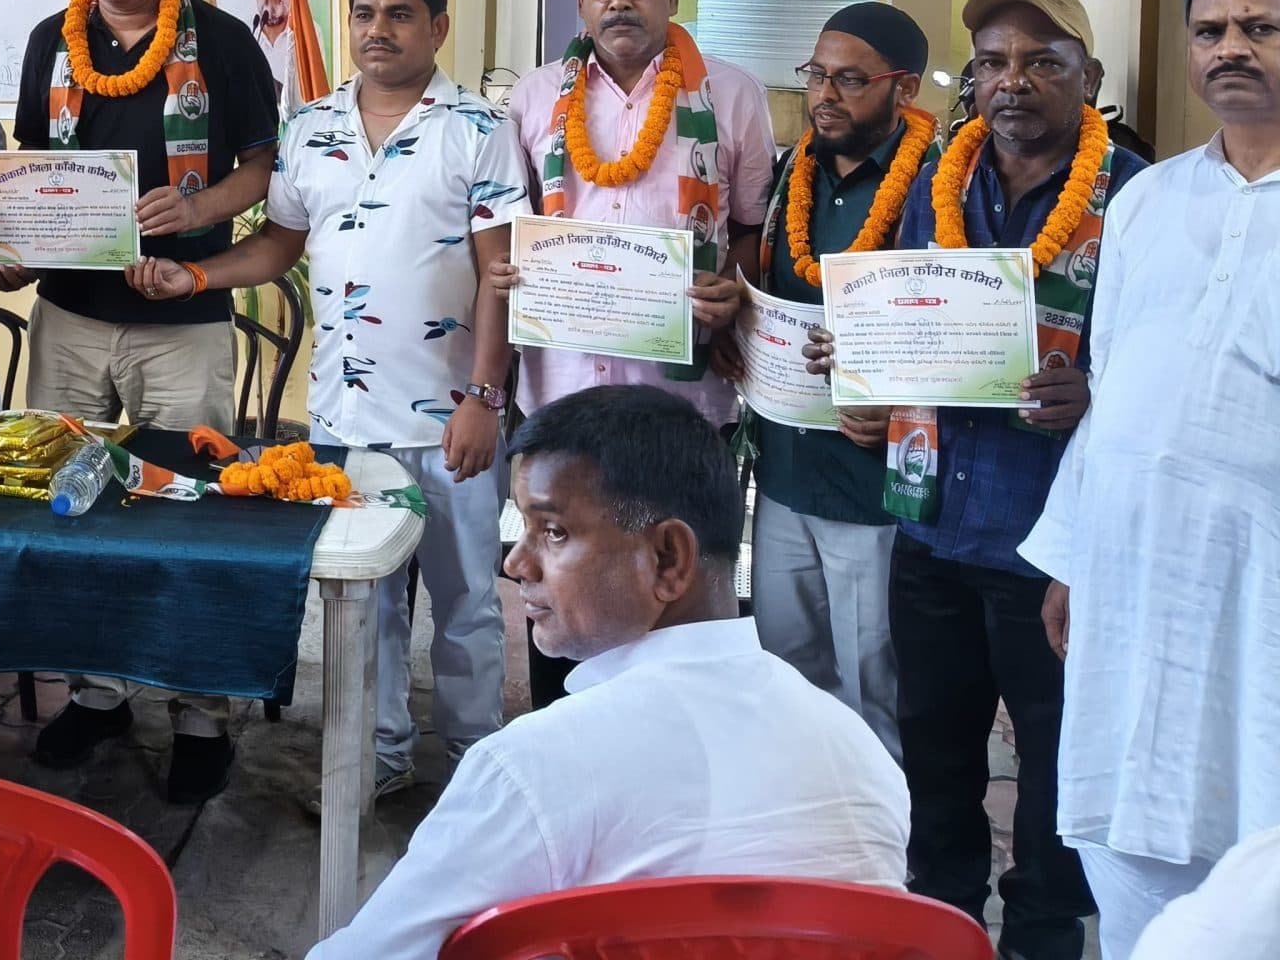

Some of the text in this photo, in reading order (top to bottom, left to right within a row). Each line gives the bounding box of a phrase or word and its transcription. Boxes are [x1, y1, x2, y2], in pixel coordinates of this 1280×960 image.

[29, 162, 52, 174] जिला
[567, 233, 594, 246] जिला
[879, 266, 910, 280] जिला
[960, 269, 1003, 290] कमिटी
